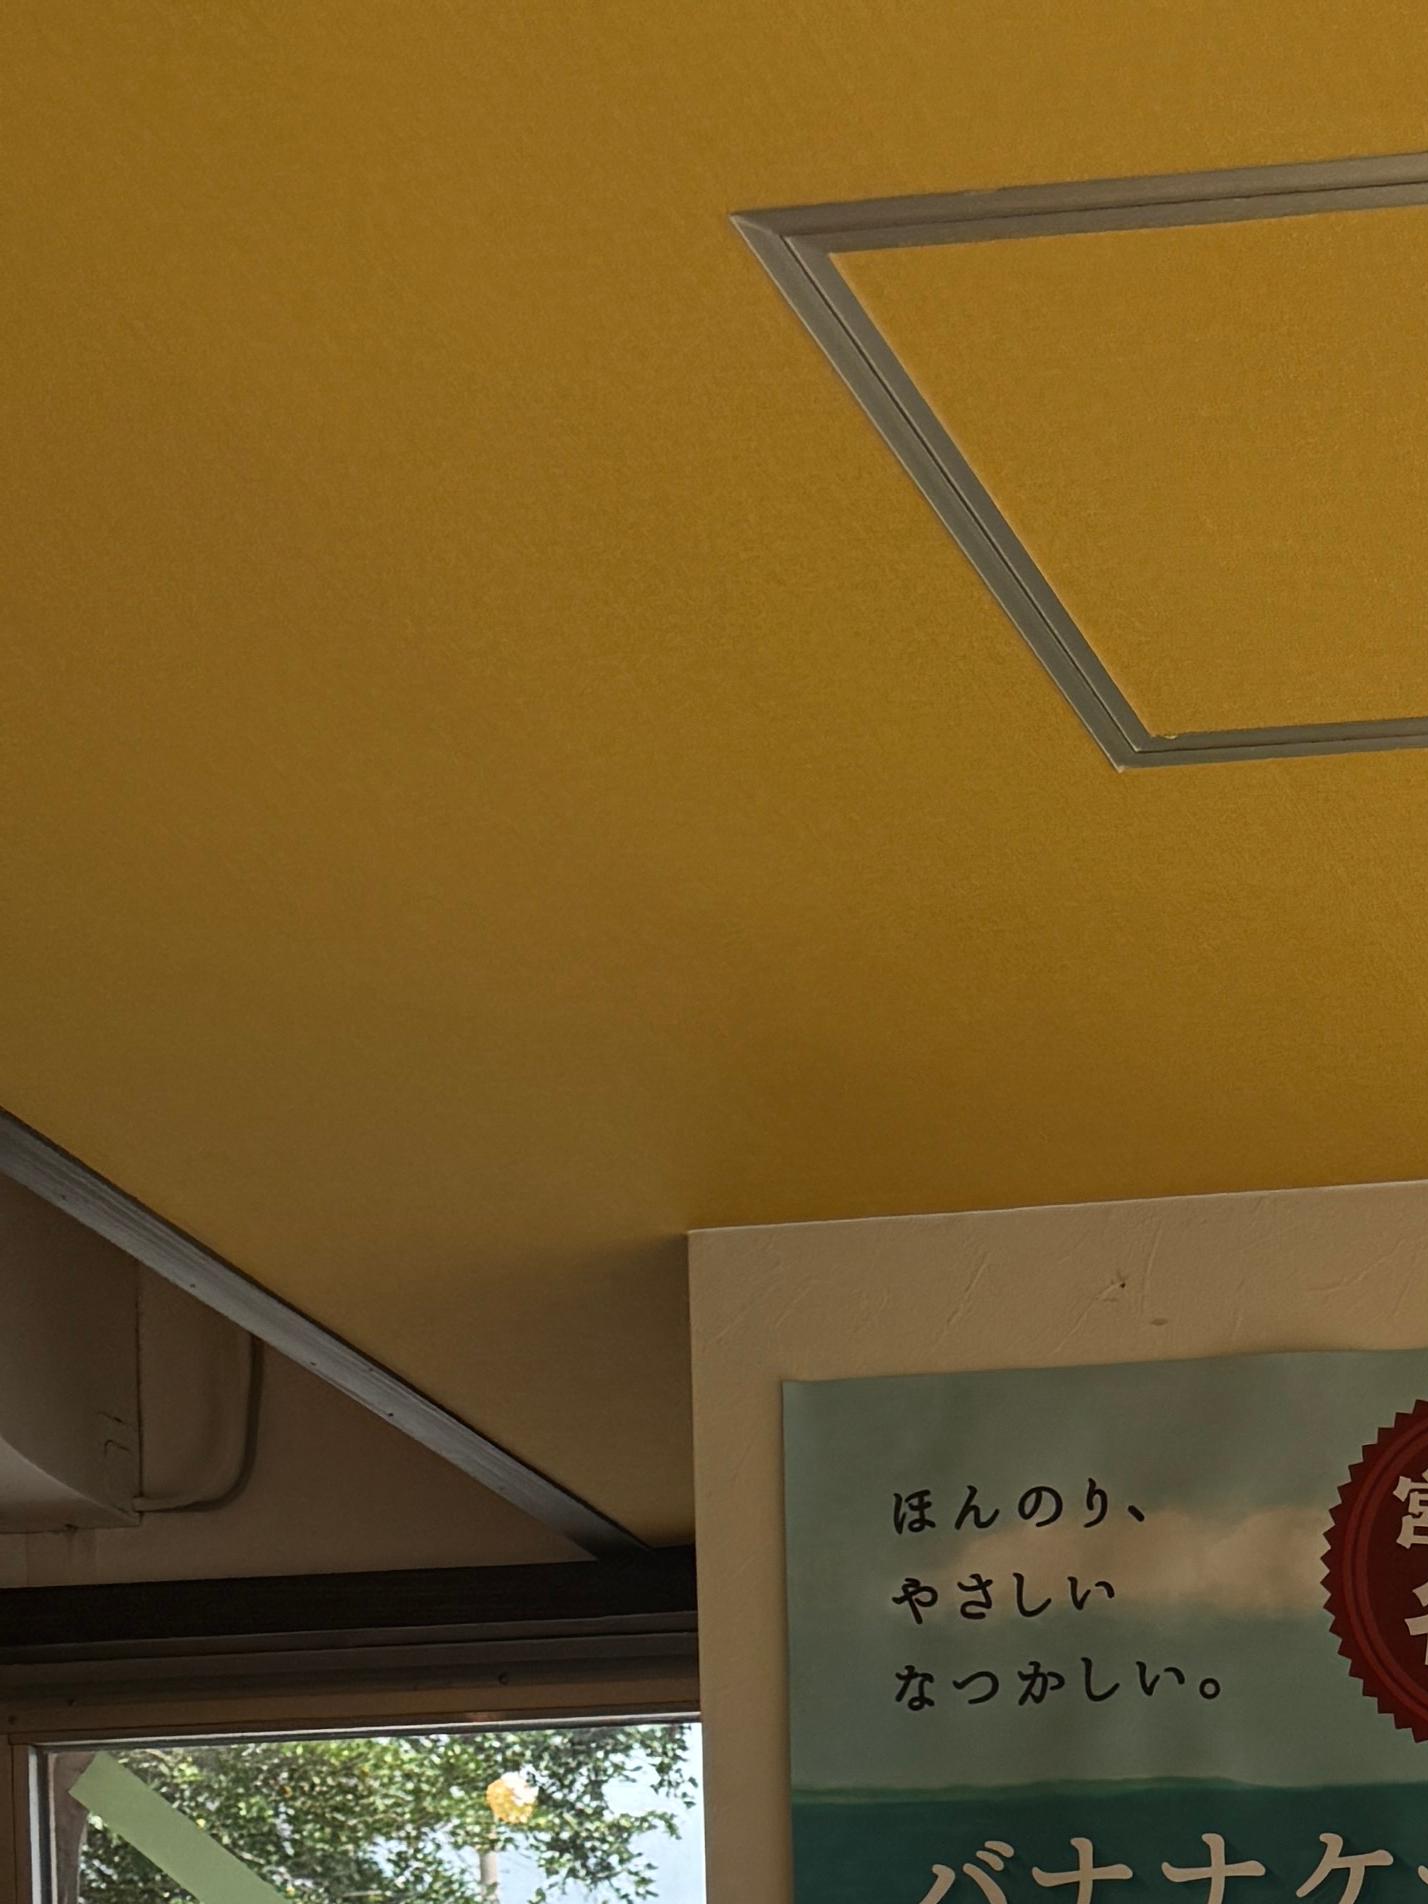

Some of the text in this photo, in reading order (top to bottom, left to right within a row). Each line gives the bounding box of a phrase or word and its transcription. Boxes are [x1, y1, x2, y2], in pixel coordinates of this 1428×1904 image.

[892, 1477, 1147, 1535] ほんのり、
[892, 1572, 1117, 1625] やさしい
[893, 1656, 1224, 1711] なつかしい。
